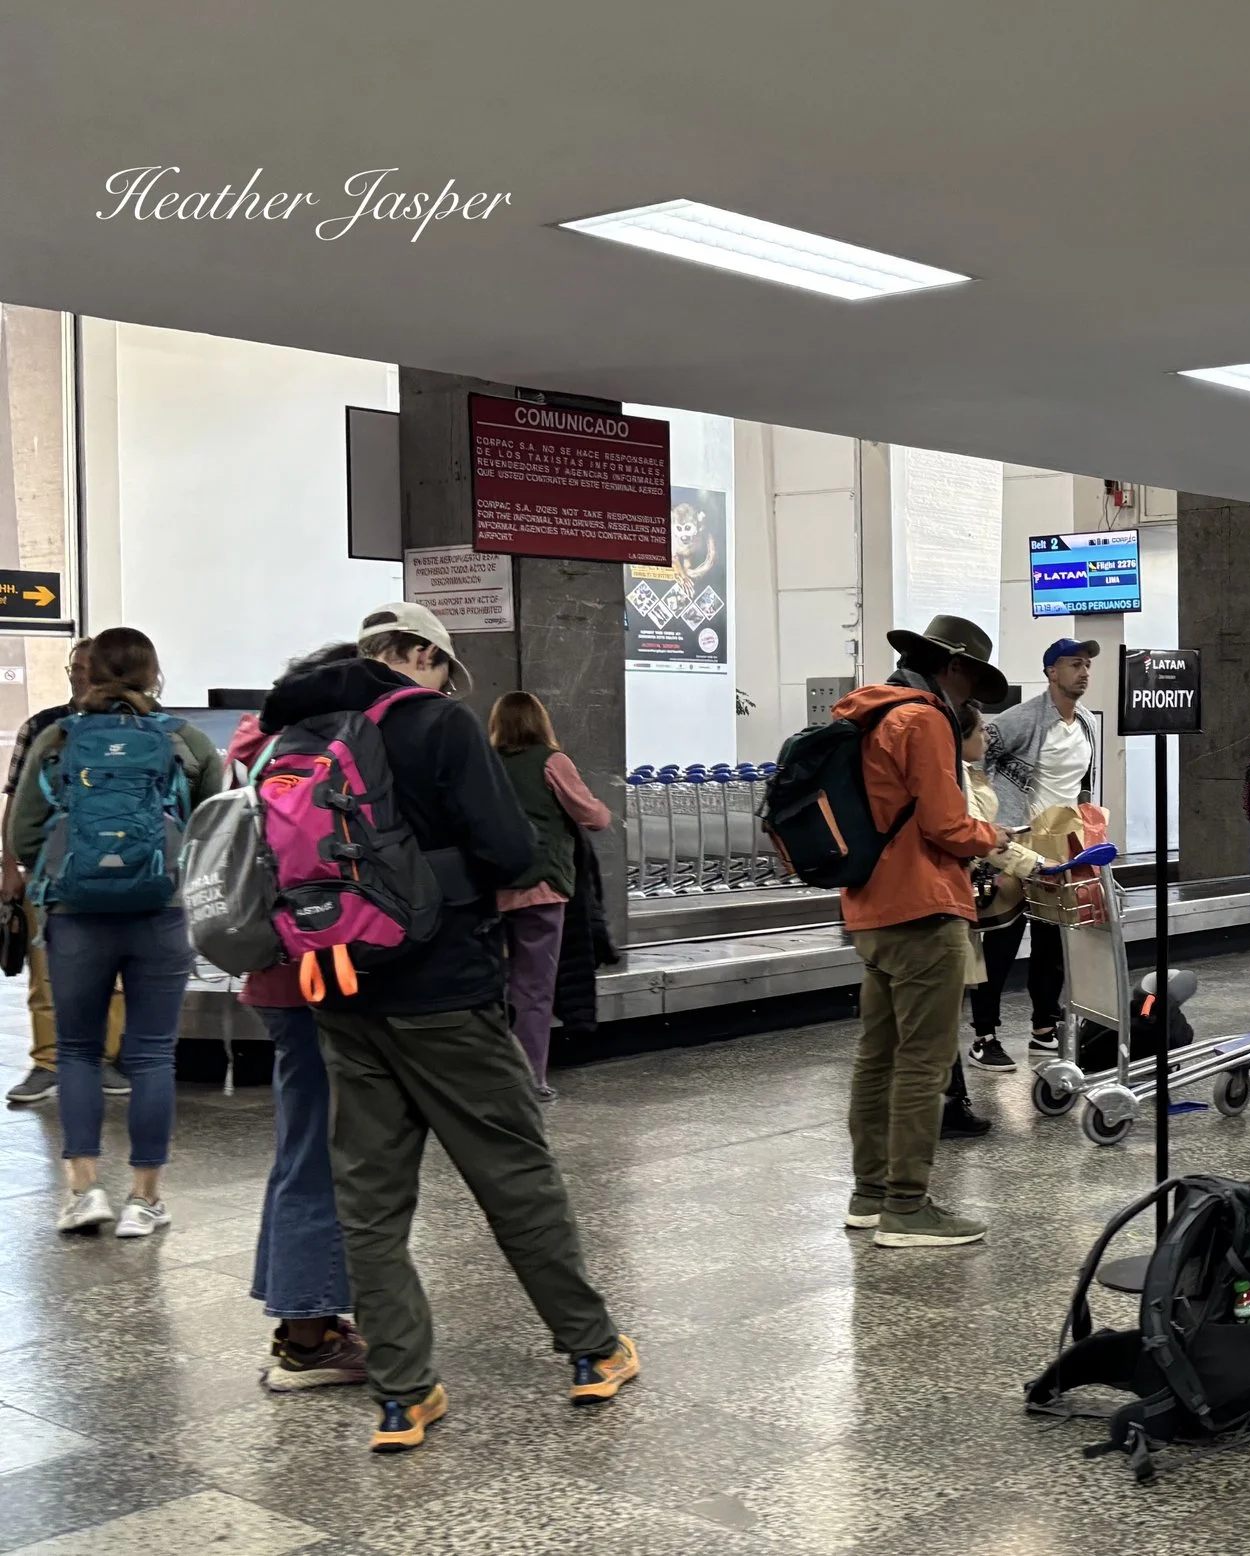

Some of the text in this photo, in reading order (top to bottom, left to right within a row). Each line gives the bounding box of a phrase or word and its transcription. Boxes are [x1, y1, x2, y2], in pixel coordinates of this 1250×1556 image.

[514, 407, 629, 438] COMUNICADO
[476, 436, 514, 448] CORPAC
[542, 445, 555, 454] NO
[560, 447, 571, 456] SE
[576, 449, 600, 460] HACE
[604, 452, 664, 467] RESPONSABLE
[476, 446, 491, 457] DE
[498, 449, 521, 460] LOS
[528, 453, 583, 467] TAXISTAS
[477, 457, 665, 486] REVENDEDORES Y AGENCIAS INFORMALES
[477, 467, 495, 477] QUE
[498, 470, 525, 481] USTED
[525, 473, 567, 486] CONTRATE
[568, 478, 578, 487] EN
[580, 479, 600, 489] ESTE
[601, 481, 638, 493] TERMINAL
[477, 499, 511, 510] CORPAC
[535, 505, 558, 515] DOES
[561, 508, 579, 517] NOT
[582, 509, 603, 519] TAKE
[606, 511, 665, 525] RESPONSIBILITY
[477, 509, 494, 519] FOR
[495, 511, 512, 521] THE
[513, 513, 553, 525] INFORMAL
[554, 516, 571, 527] TAXI
[607, 522, 650, 533] RESELLERS
[651, 526, 667, 535] AND
[478, 520, 666, 544] INFORMAL AGENCIES THAT YOU CONTRACT ON THIS
[1031, 537, 1059, 550] Belt 2
[450, 565, 468, 574] TODO
[469, 564, 486, 573] ACTO
[487, 563, 497, 572] DE
[1096, 559, 1137, 571] Flight 2276
[1043, 571, 1088, 581] LATAM
[1105, 576, 1120, 585] LIMA
[466, 605, 503, 615] PROHIBITED
[1088, 600, 1132, 610] PERUANOS
[1152, 659, 1186, 670] LATAM
[1132, 689, 1194, 708] PRIORITY
